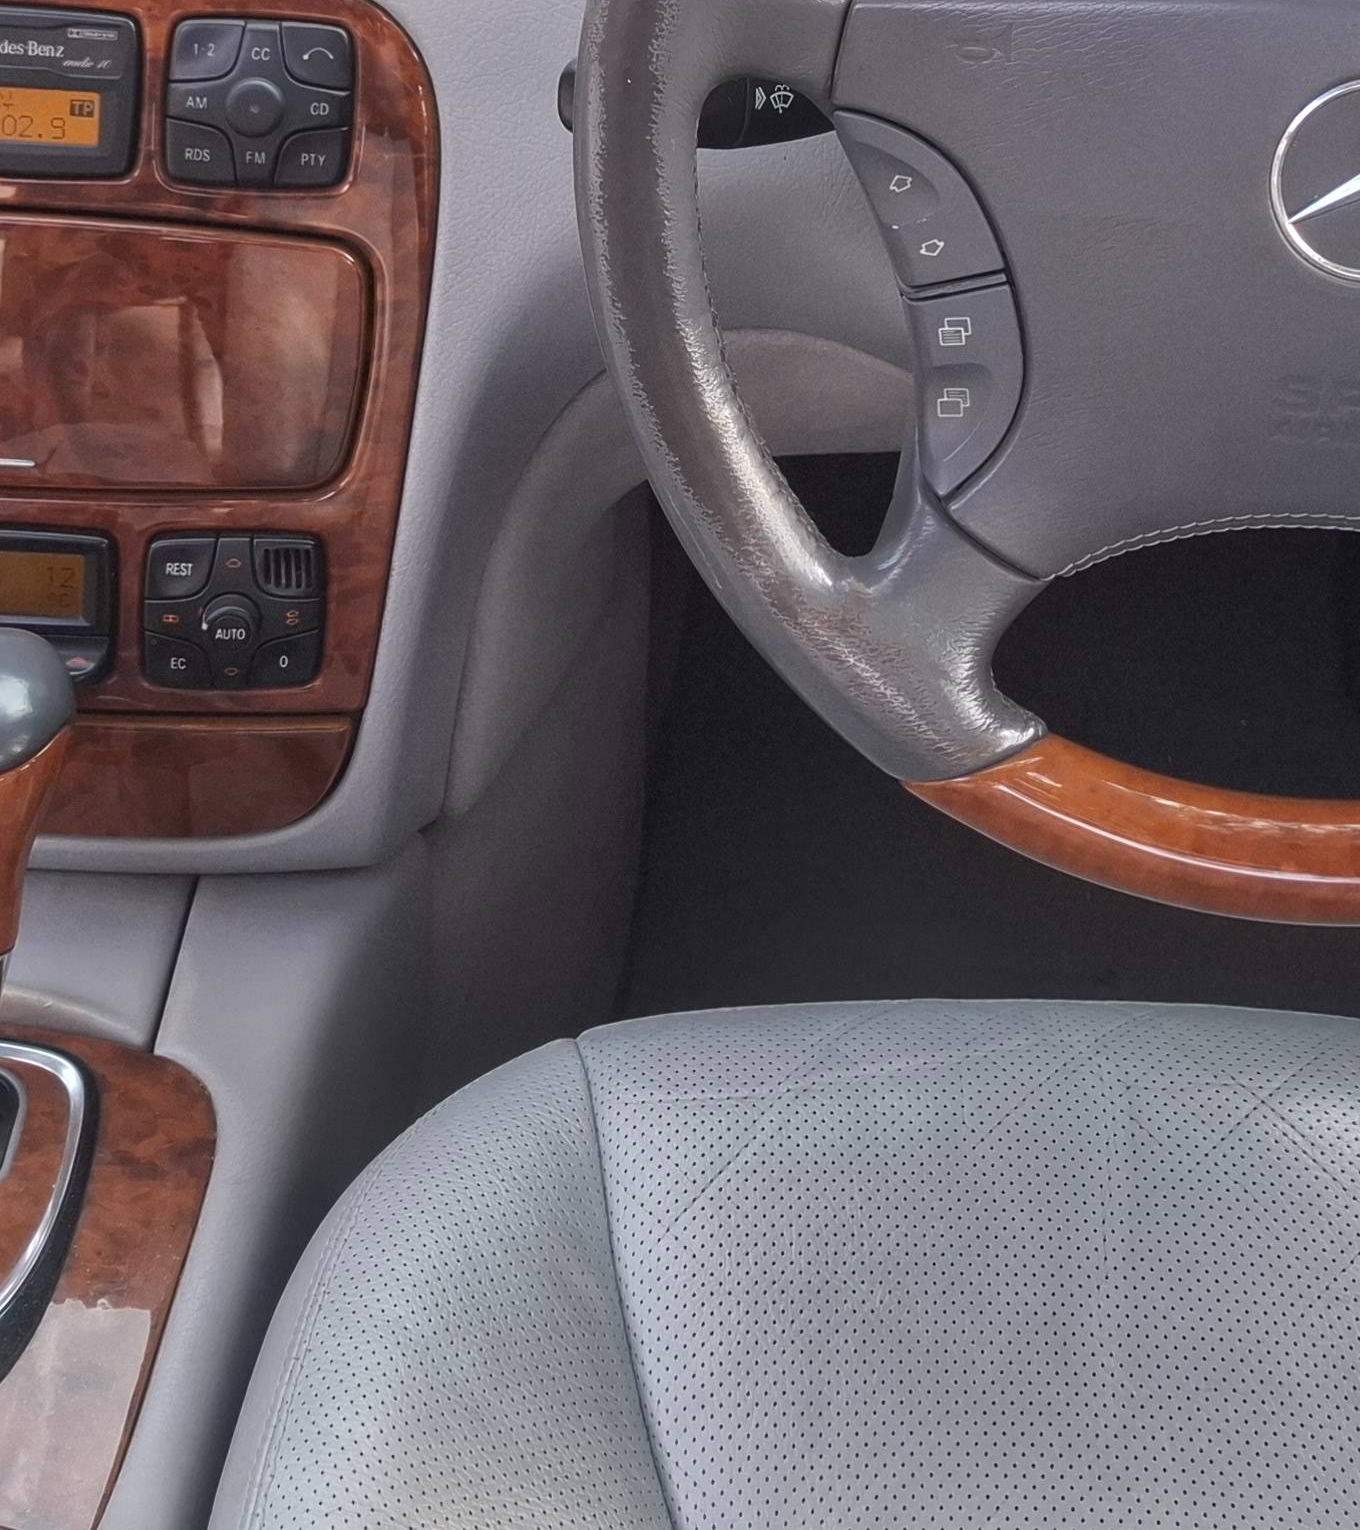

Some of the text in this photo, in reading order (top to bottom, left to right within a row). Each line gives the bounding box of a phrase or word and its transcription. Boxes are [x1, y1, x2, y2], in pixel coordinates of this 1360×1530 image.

[251, 47, 271, 61] CC
[70, 99, 96, 118] TP
[185, 96, 208, 109] AM
[310, 102, 330, 115] CD
[185, 148, 211, 162] RDS
[246, 151, 266, 164] FM
[301, 153, 326, 167] PTY
[165, 562, 193, 576] REST
[215, 628, 246, 640] AUTO
[170, 657, 187, 670] EC
